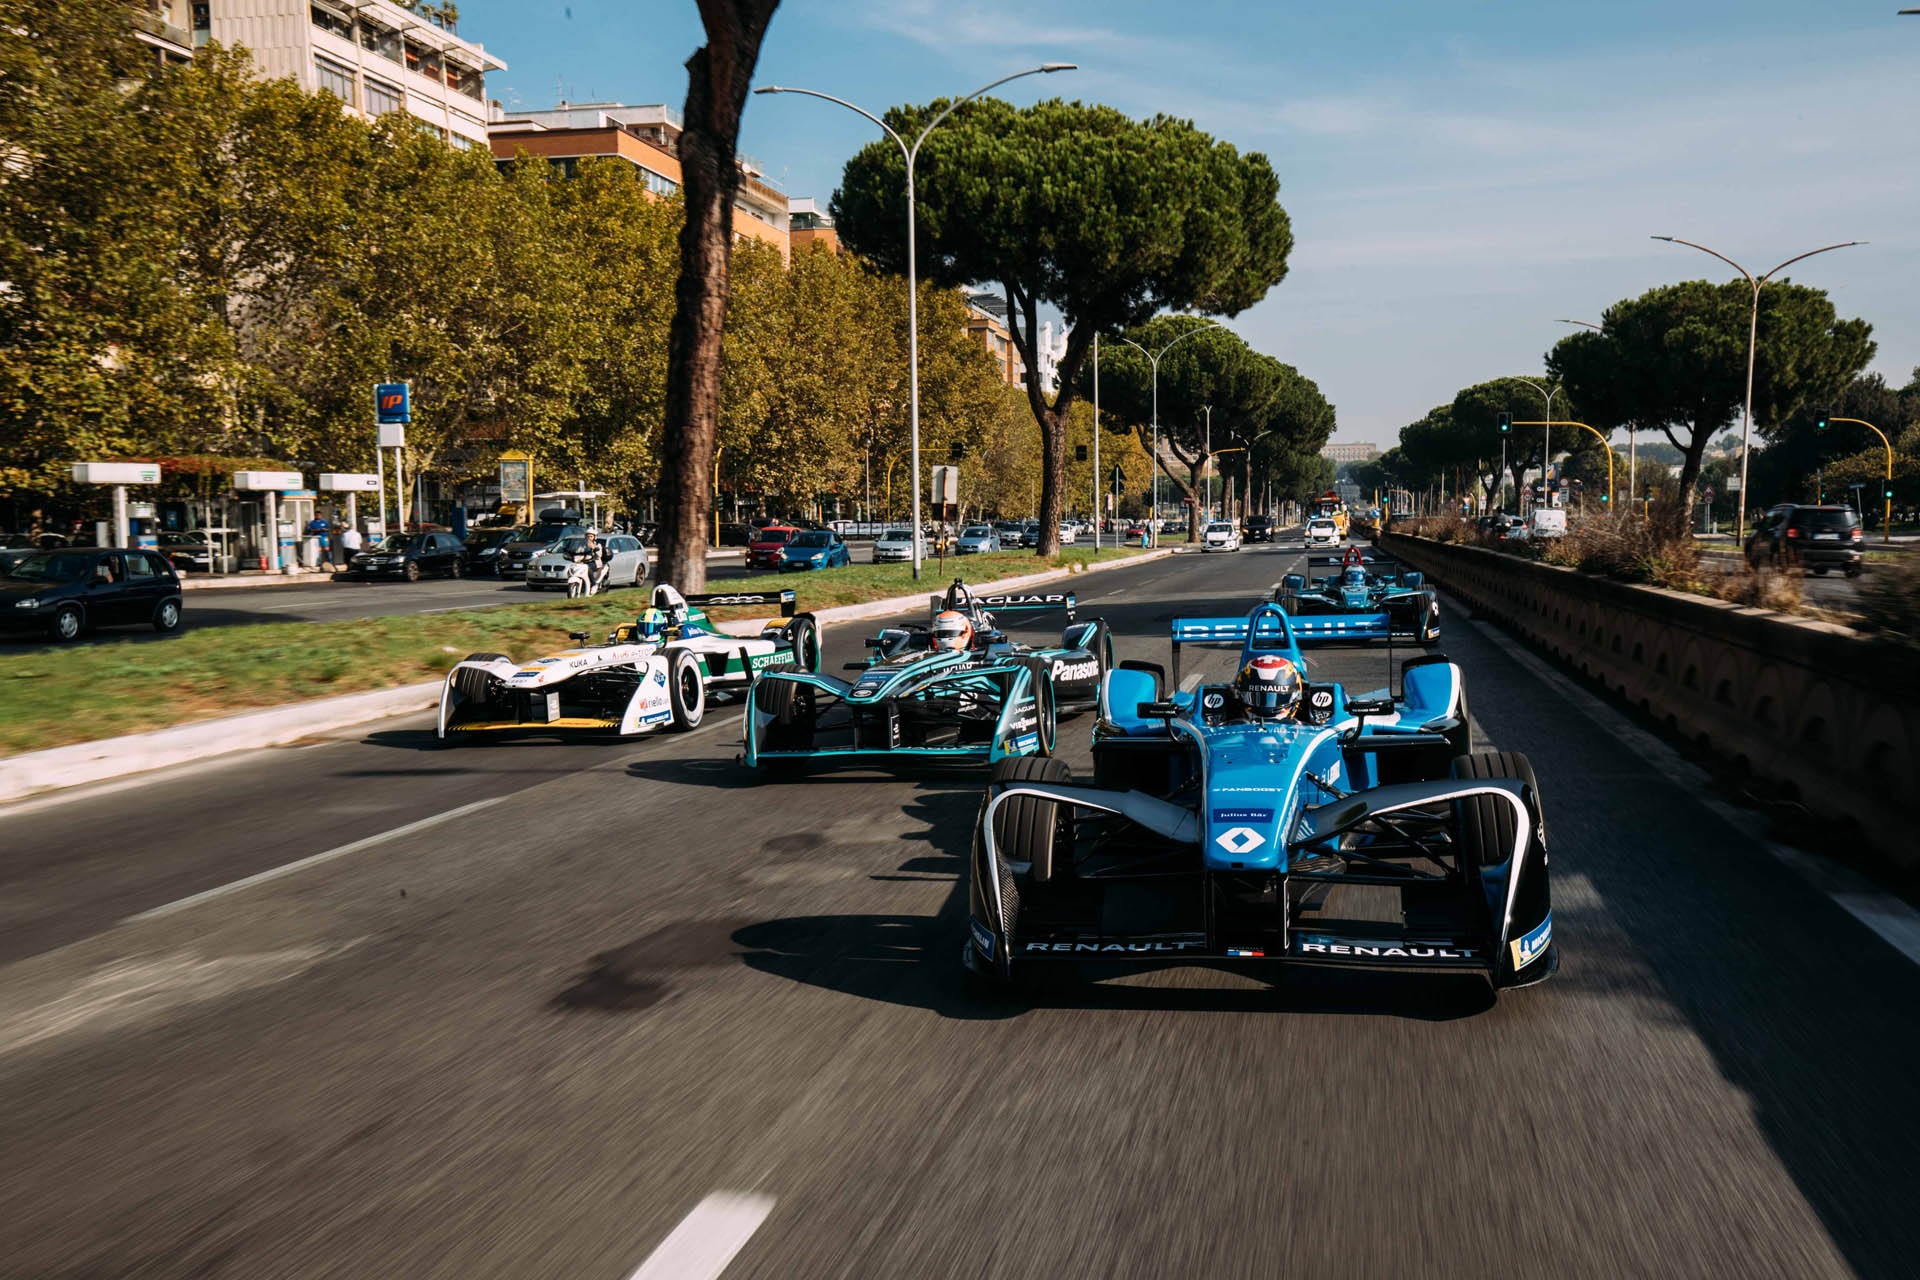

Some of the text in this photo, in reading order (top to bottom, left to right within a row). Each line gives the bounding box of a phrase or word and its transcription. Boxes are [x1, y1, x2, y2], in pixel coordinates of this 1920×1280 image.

[956, 594, 1064, 605] JAGUAR
[569, 659, 588, 669] KUKA
[752, 650, 794, 669] SCHAEFFLER
[1248, 684, 1290, 693] RENAULT
[1208, 693, 1222, 709] hp
[1314, 691, 1330, 708] hp
[1026, 941, 1193, 952] RENAULT
[1302, 943, 1480, 958] RENAULT
